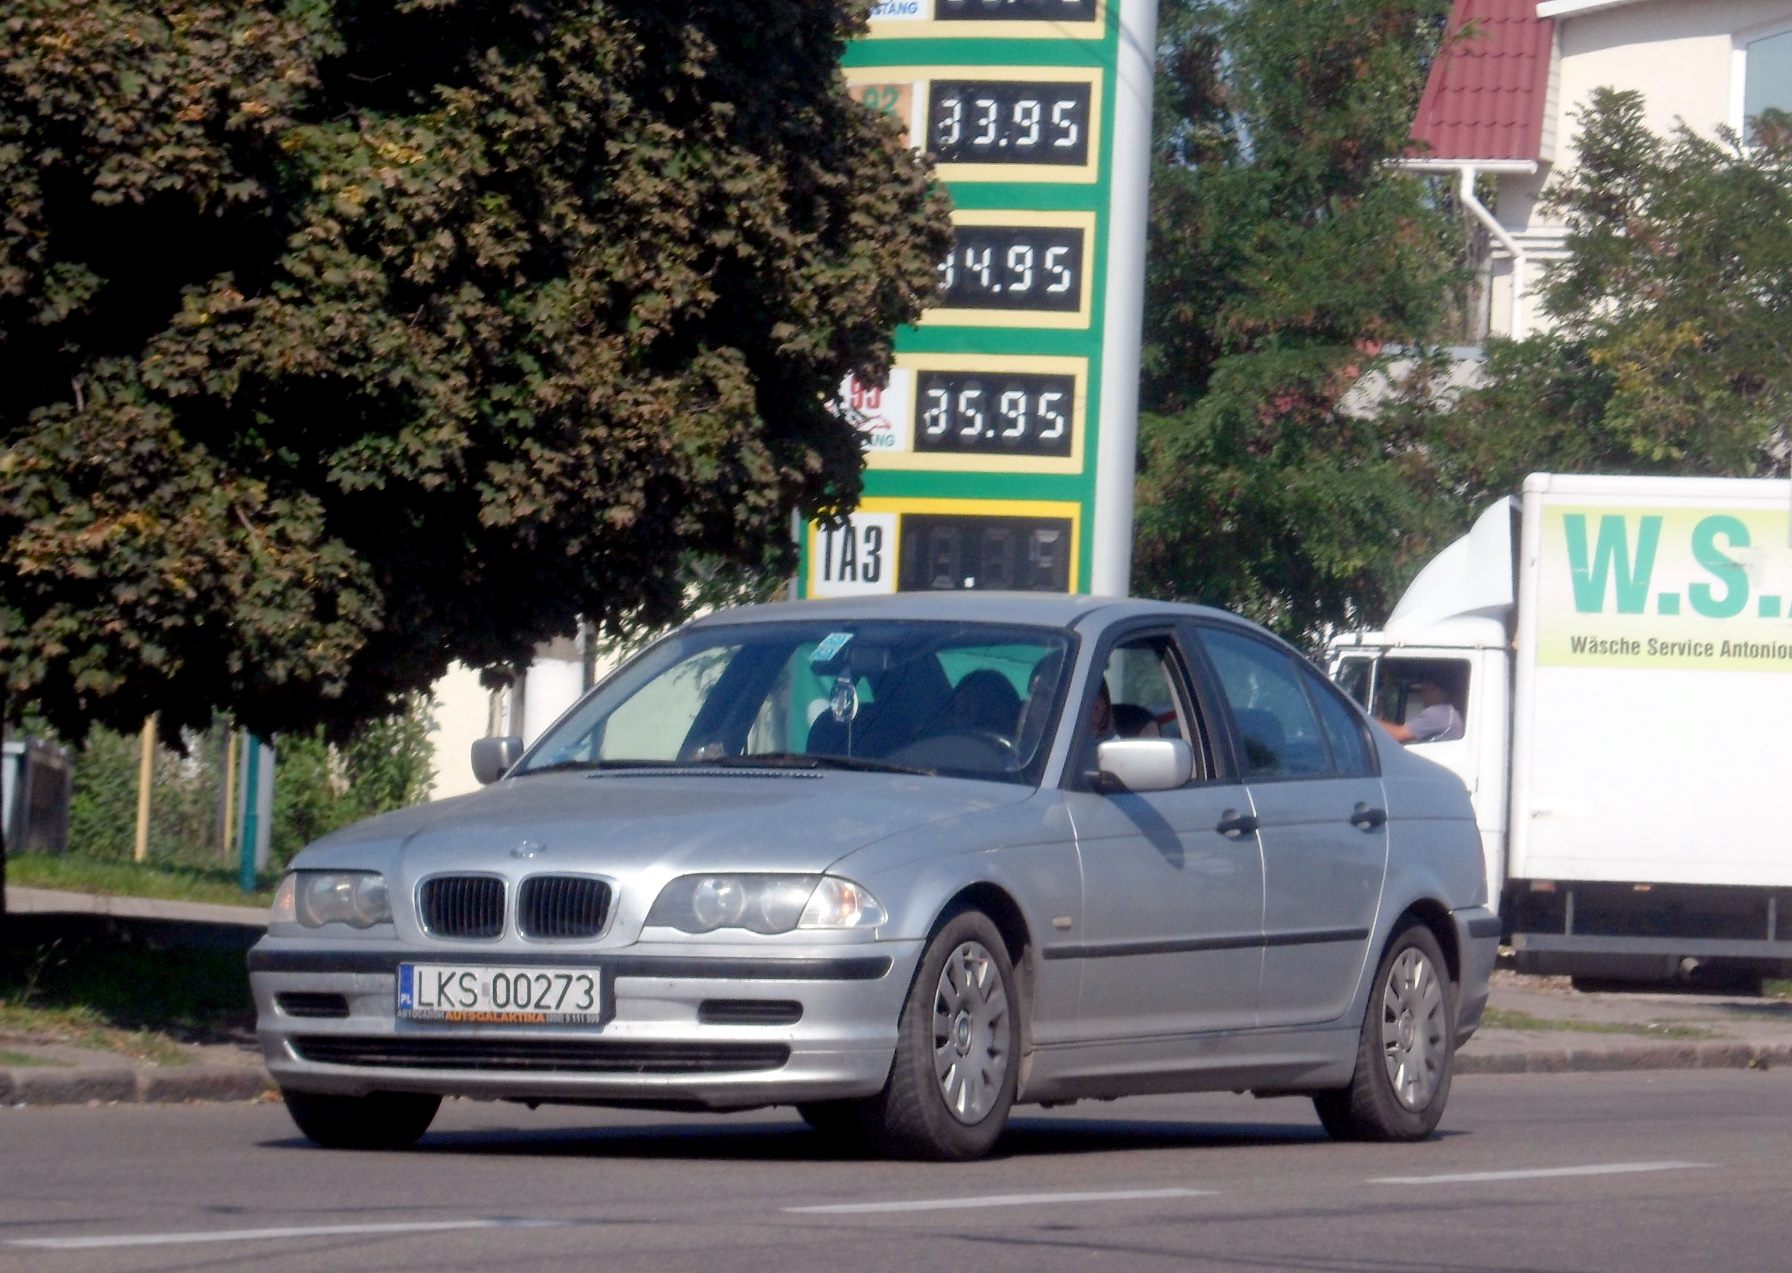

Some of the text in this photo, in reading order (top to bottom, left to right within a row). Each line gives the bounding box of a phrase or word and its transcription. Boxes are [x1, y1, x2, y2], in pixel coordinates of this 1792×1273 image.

[939, 99, 1078, 147] 33.95
[924, 389, 1065, 438] 35.95
[1563, 512, 1792, 619] W.S.
[1571, 635, 1640, 655] Wäsche
[1648, 638, 1714, 657] Service
[401, 993, 412, 1004] PL
[418, 970, 595, 1011] LKS 00273
